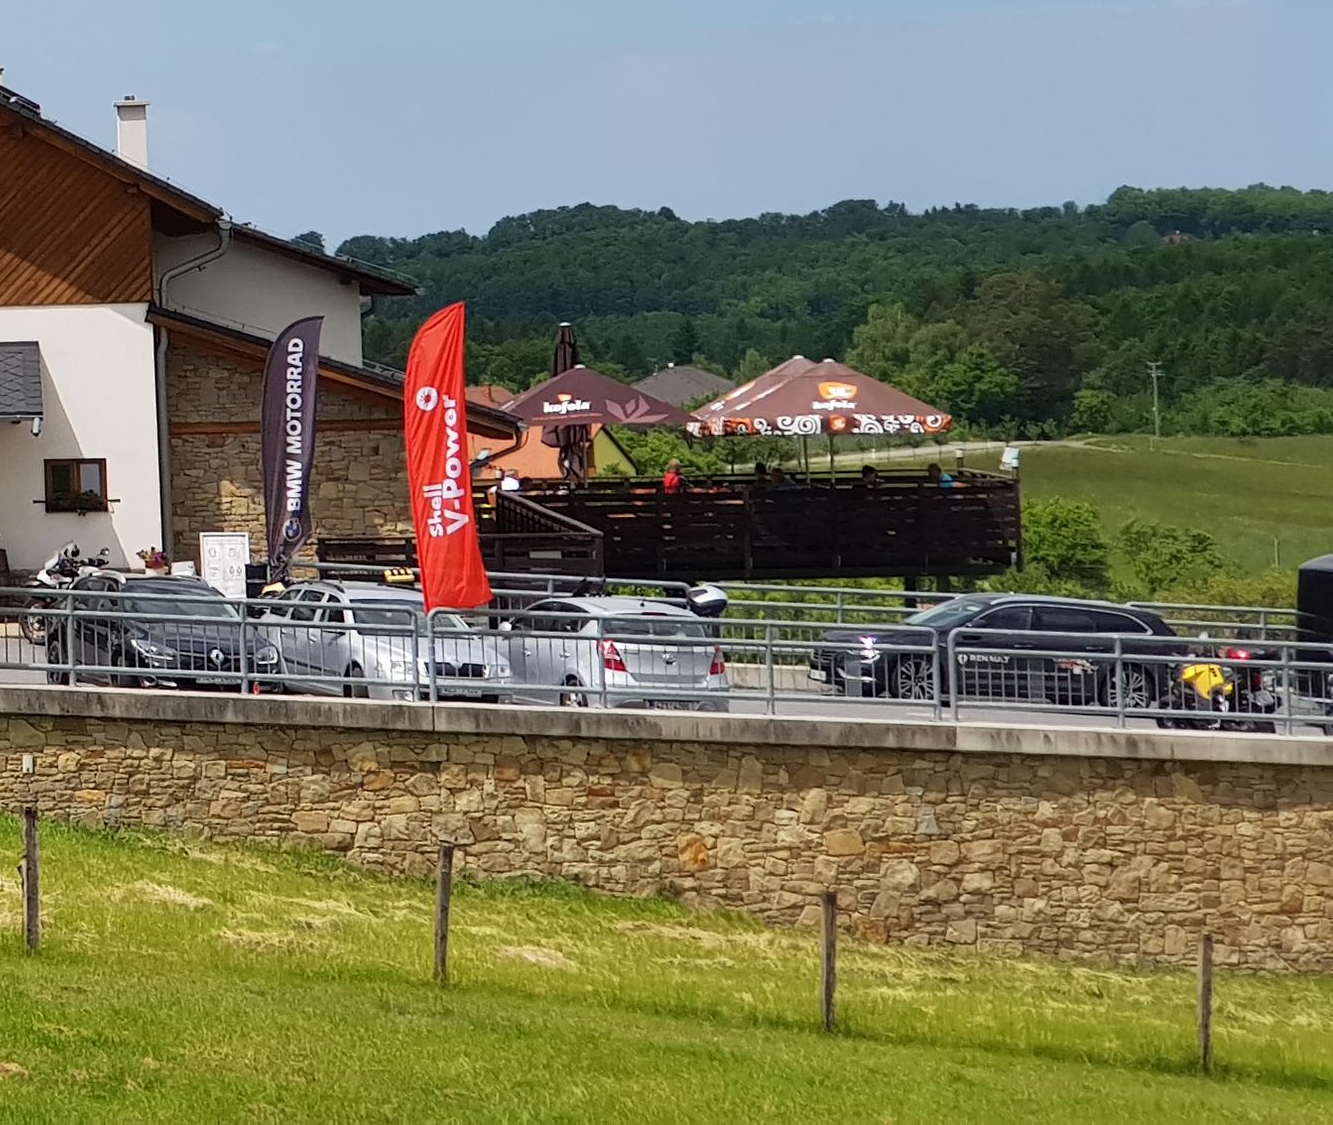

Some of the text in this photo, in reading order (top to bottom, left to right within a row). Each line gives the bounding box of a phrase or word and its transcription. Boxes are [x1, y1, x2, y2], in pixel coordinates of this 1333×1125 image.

[286, 337, 304, 512] BMW MOTORRAD
[442, 394, 469, 535] V-Power
[969, 654, 1011, 664] RENAULT
